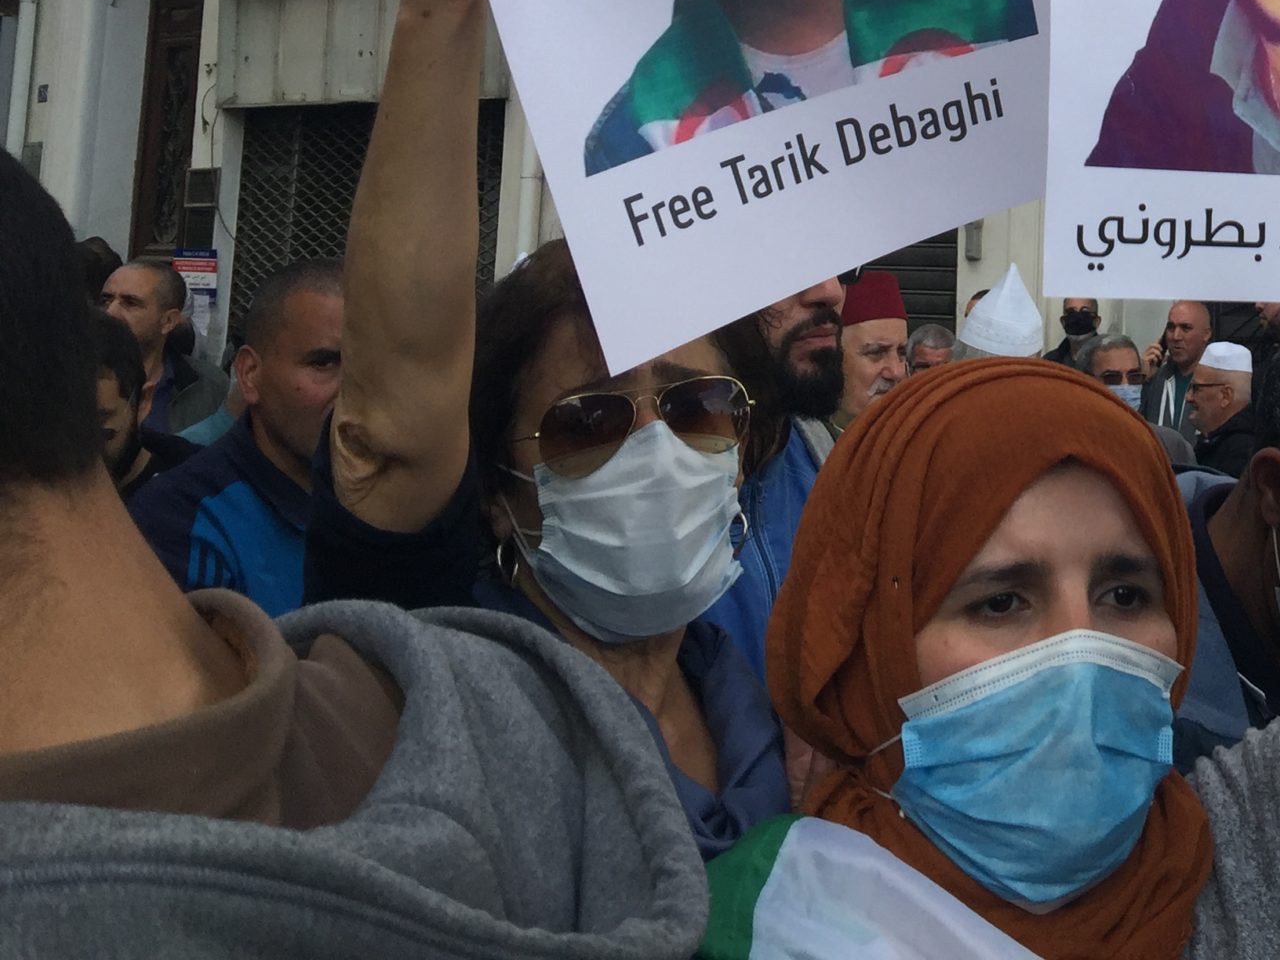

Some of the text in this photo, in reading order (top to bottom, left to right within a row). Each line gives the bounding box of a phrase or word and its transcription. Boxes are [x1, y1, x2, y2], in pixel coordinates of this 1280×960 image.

[623, 78, 1004, 246] Free Tarik Debaghi
[1076, 203, 1266, 272] بطروني
